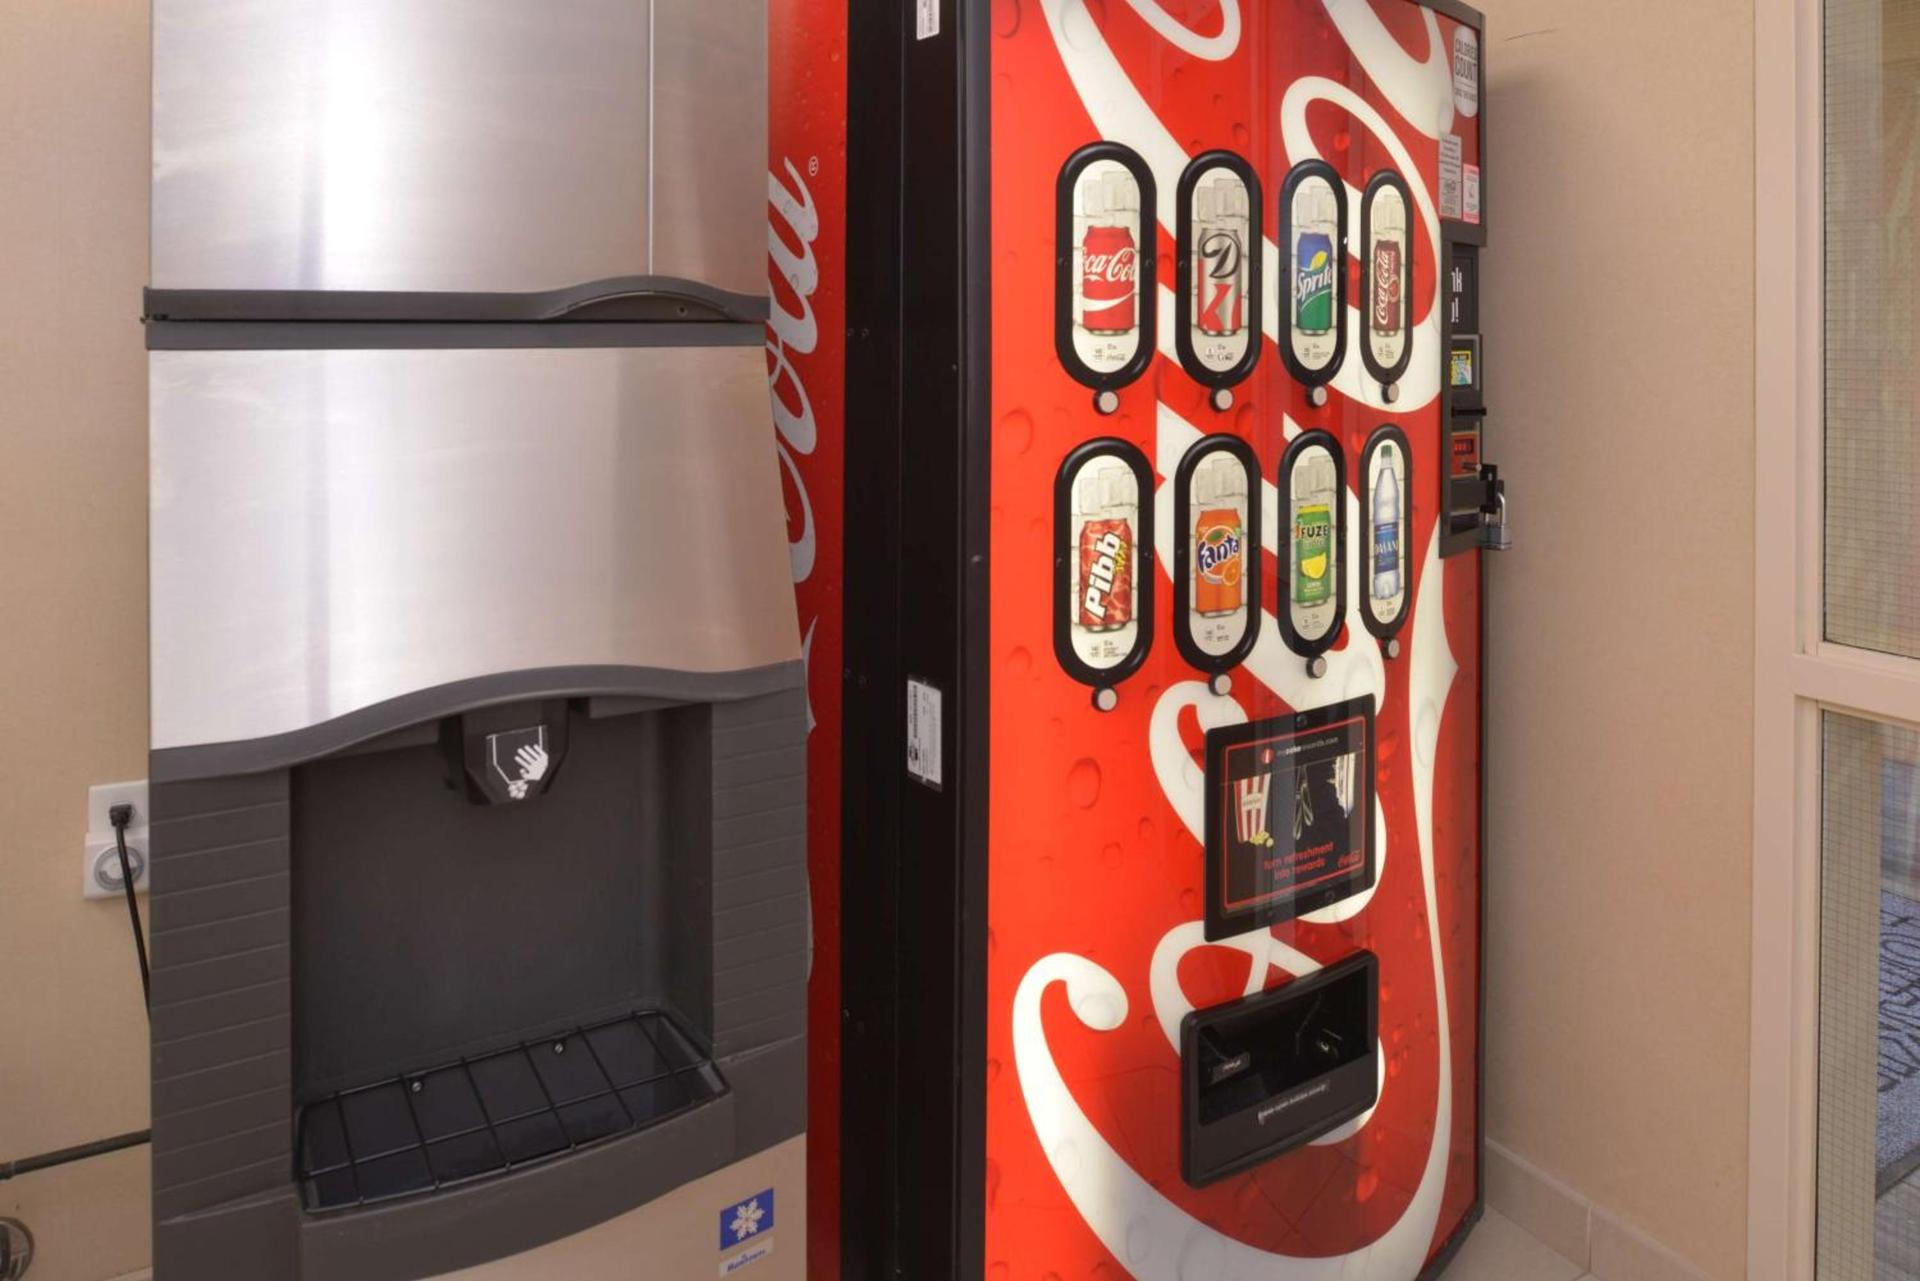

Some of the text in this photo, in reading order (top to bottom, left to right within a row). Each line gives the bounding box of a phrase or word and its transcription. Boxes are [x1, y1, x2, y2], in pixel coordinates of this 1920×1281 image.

[1301, 524, 1328, 538] FUZE
[1084, 530, 1122, 620] Pibb
[1198, 533, 1240, 575] Fanta
